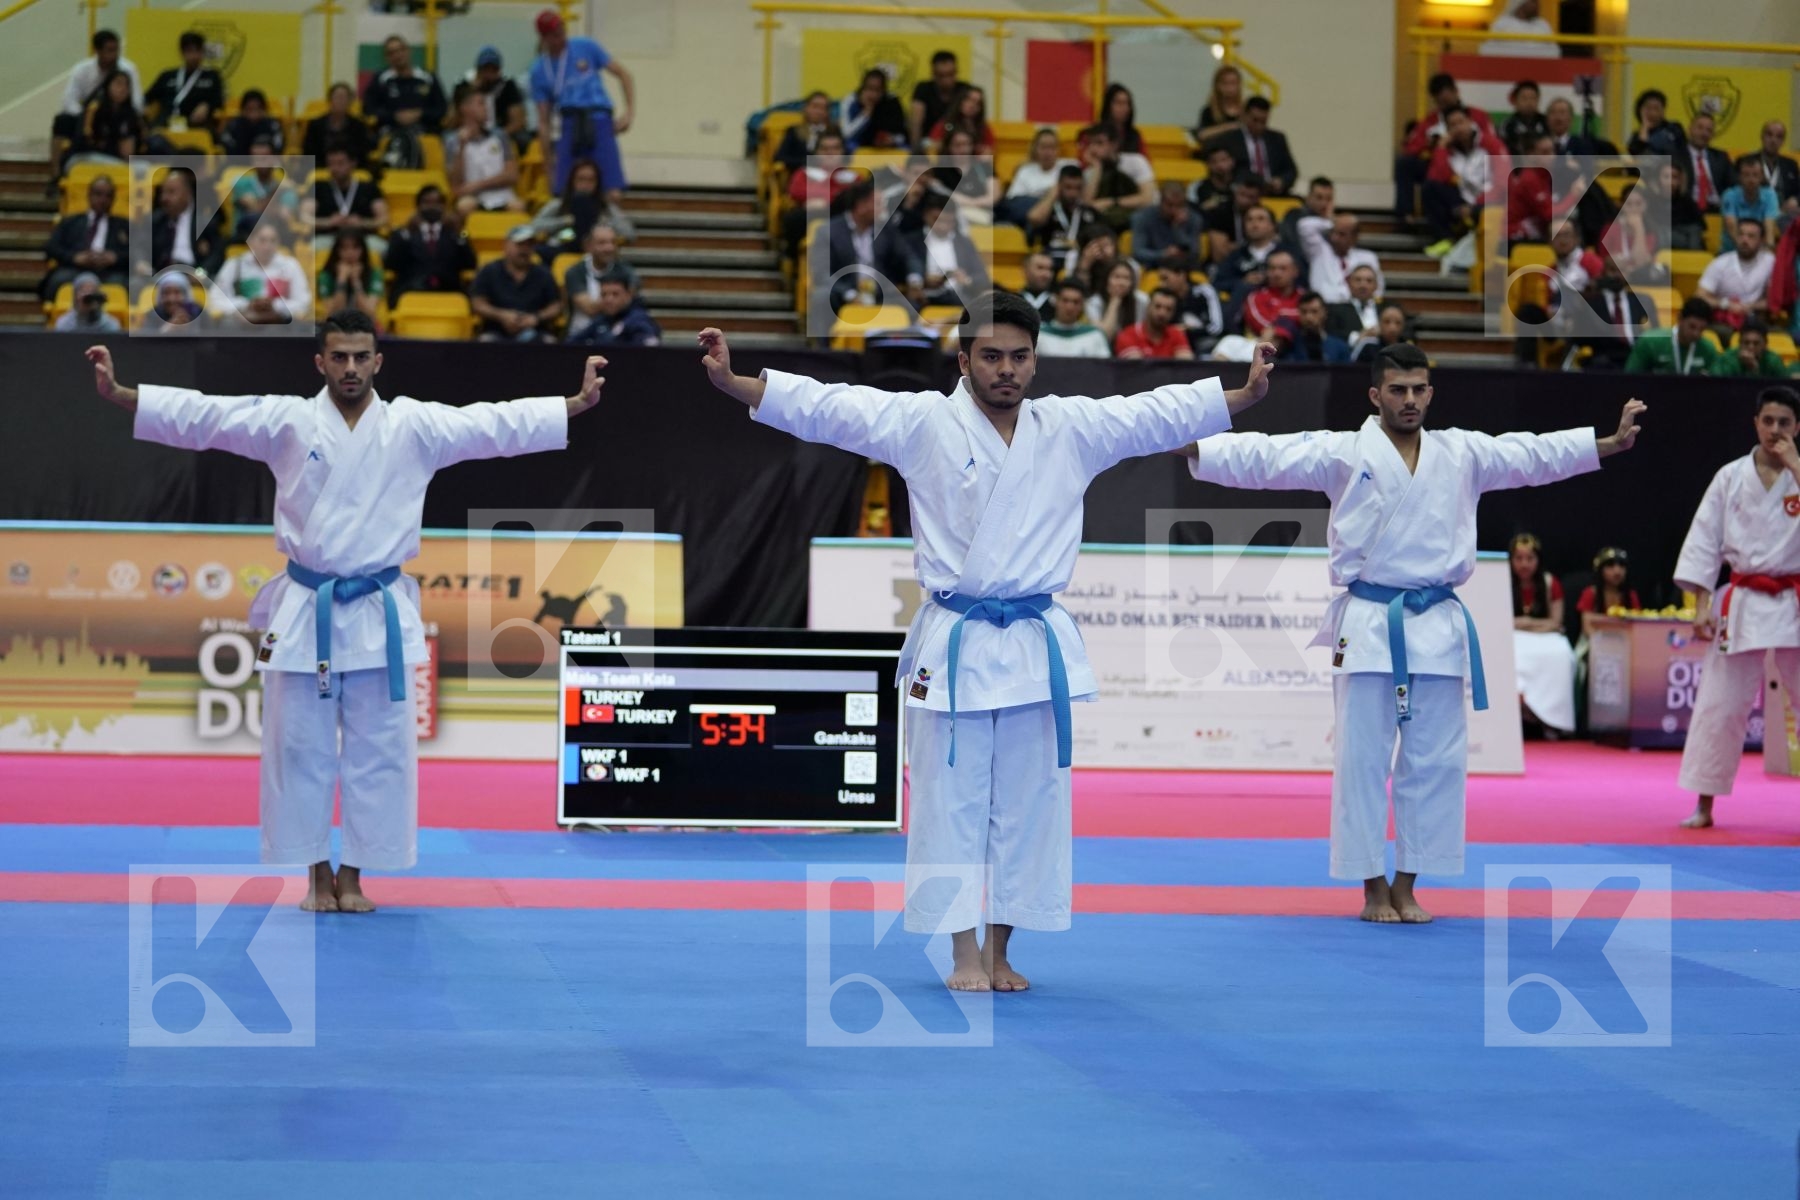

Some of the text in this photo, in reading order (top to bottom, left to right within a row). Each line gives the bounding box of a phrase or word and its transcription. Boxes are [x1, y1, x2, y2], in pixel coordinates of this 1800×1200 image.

[561, 630, 621, 646] Tatami 1
[602, 671, 640, 686] Team
[643, 672, 676, 687] Kata
[582, 690, 644, 705] TURKEY
[615, 708, 677, 724] TURKEY
[700, 713, 766, 746] 5:34
[814, 731, 876, 747] Gankaku
[581, 748, 628, 764] WKF 1
[614, 767, 661, 783] WKF 1
[838, 790, 876, 805] Unsu
